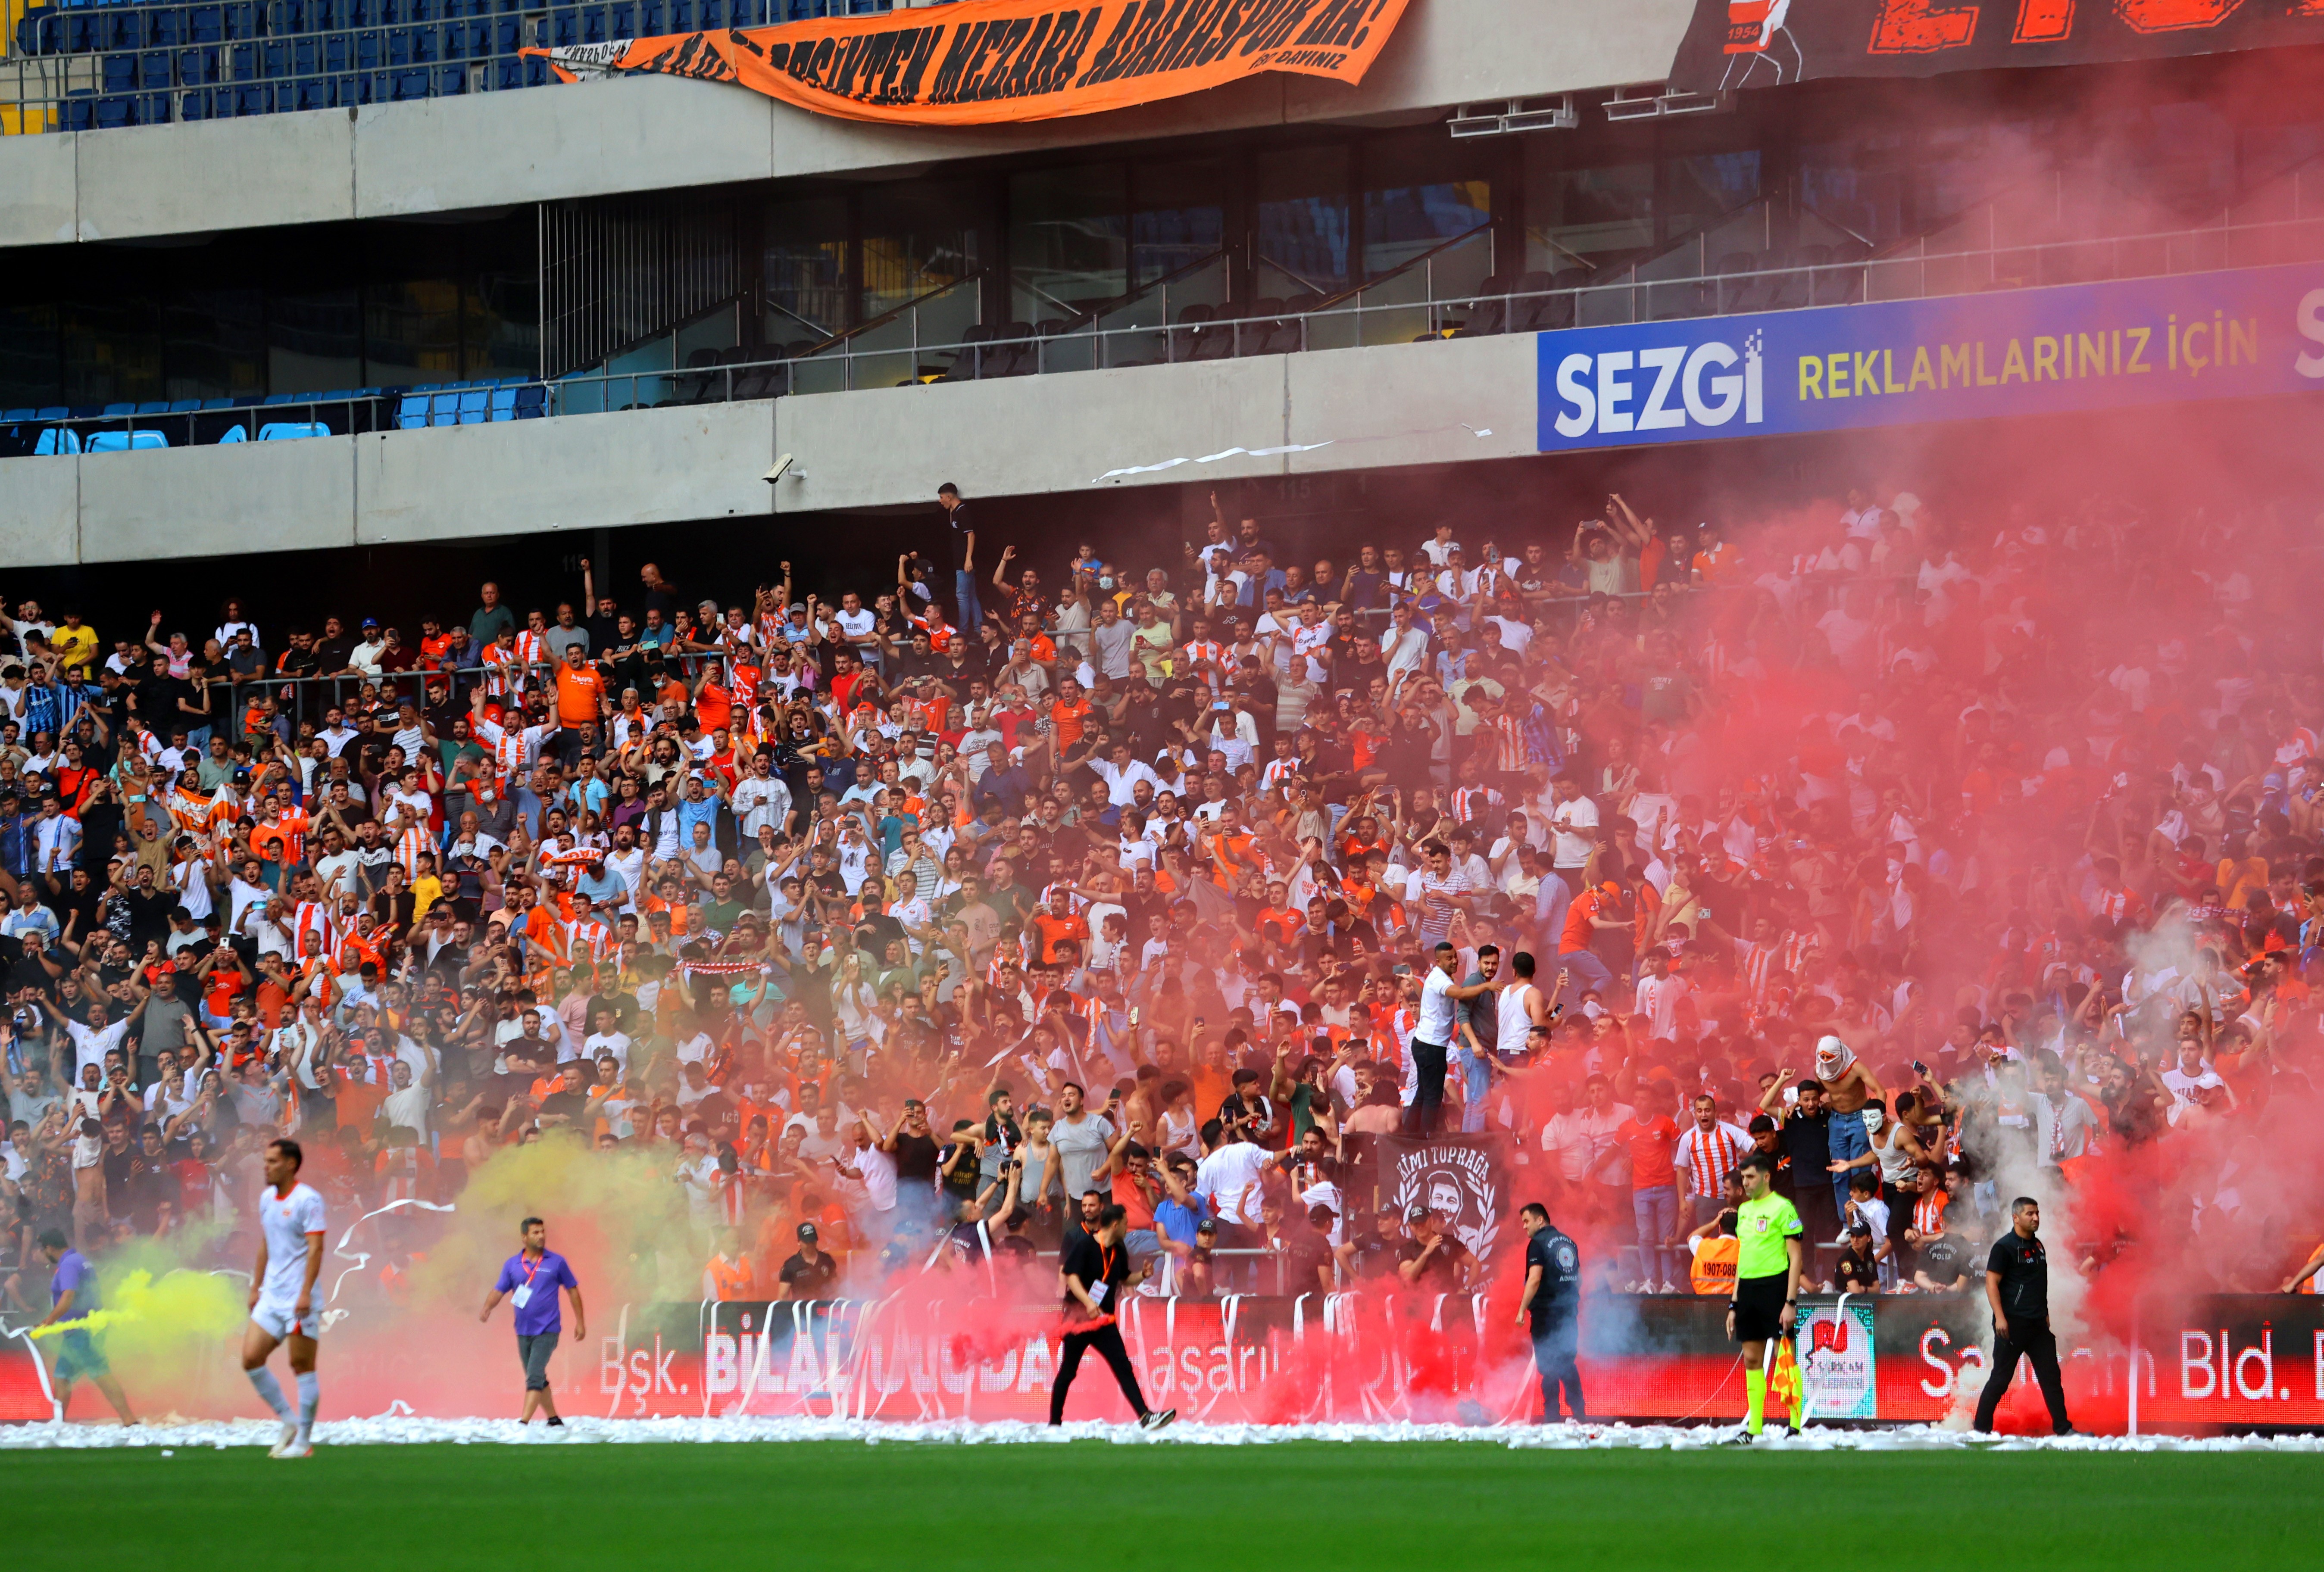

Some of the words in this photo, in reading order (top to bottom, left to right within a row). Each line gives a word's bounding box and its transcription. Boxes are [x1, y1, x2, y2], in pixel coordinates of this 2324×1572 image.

[1727, 25, 1760, 40] 1954
[1274, 50, 1347, 70] DAYINIZ
[1554, 328, 1763, 437] SEZGİ
[1798, 327, 2152, 400] REKLAMLARINIZ
[2166, 308, 2259, 378] İÇİN
[1547, 1236, 1559, 1249] SPOR
[600, 1333, 688, 1416] Bşk.
[706, 1312, 853, 1394] BİLAL
[2180, 1329, 2291, 1401] Bld.
